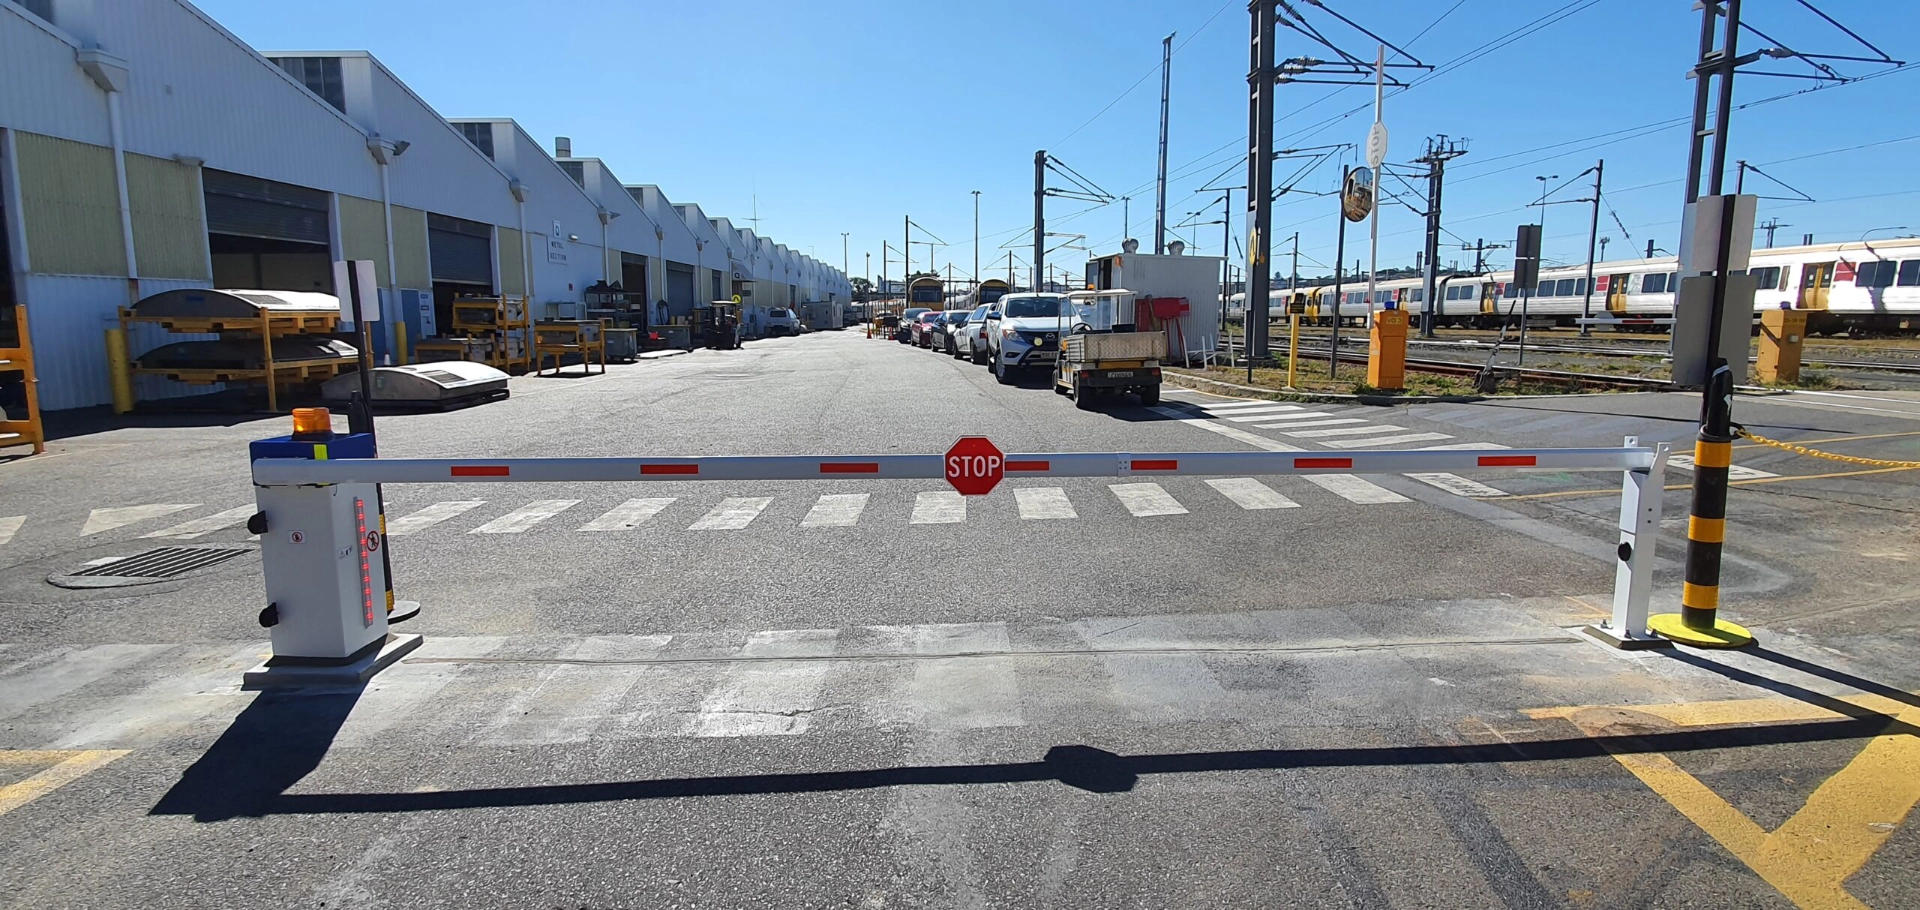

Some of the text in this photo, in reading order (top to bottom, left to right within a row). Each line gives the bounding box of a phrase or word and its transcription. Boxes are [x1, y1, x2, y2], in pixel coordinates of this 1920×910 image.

[1371, 125, 1380, 167] STOP
[550, 253, 566, 261] SECTION
[948, 455, 1001, 478] STOP
